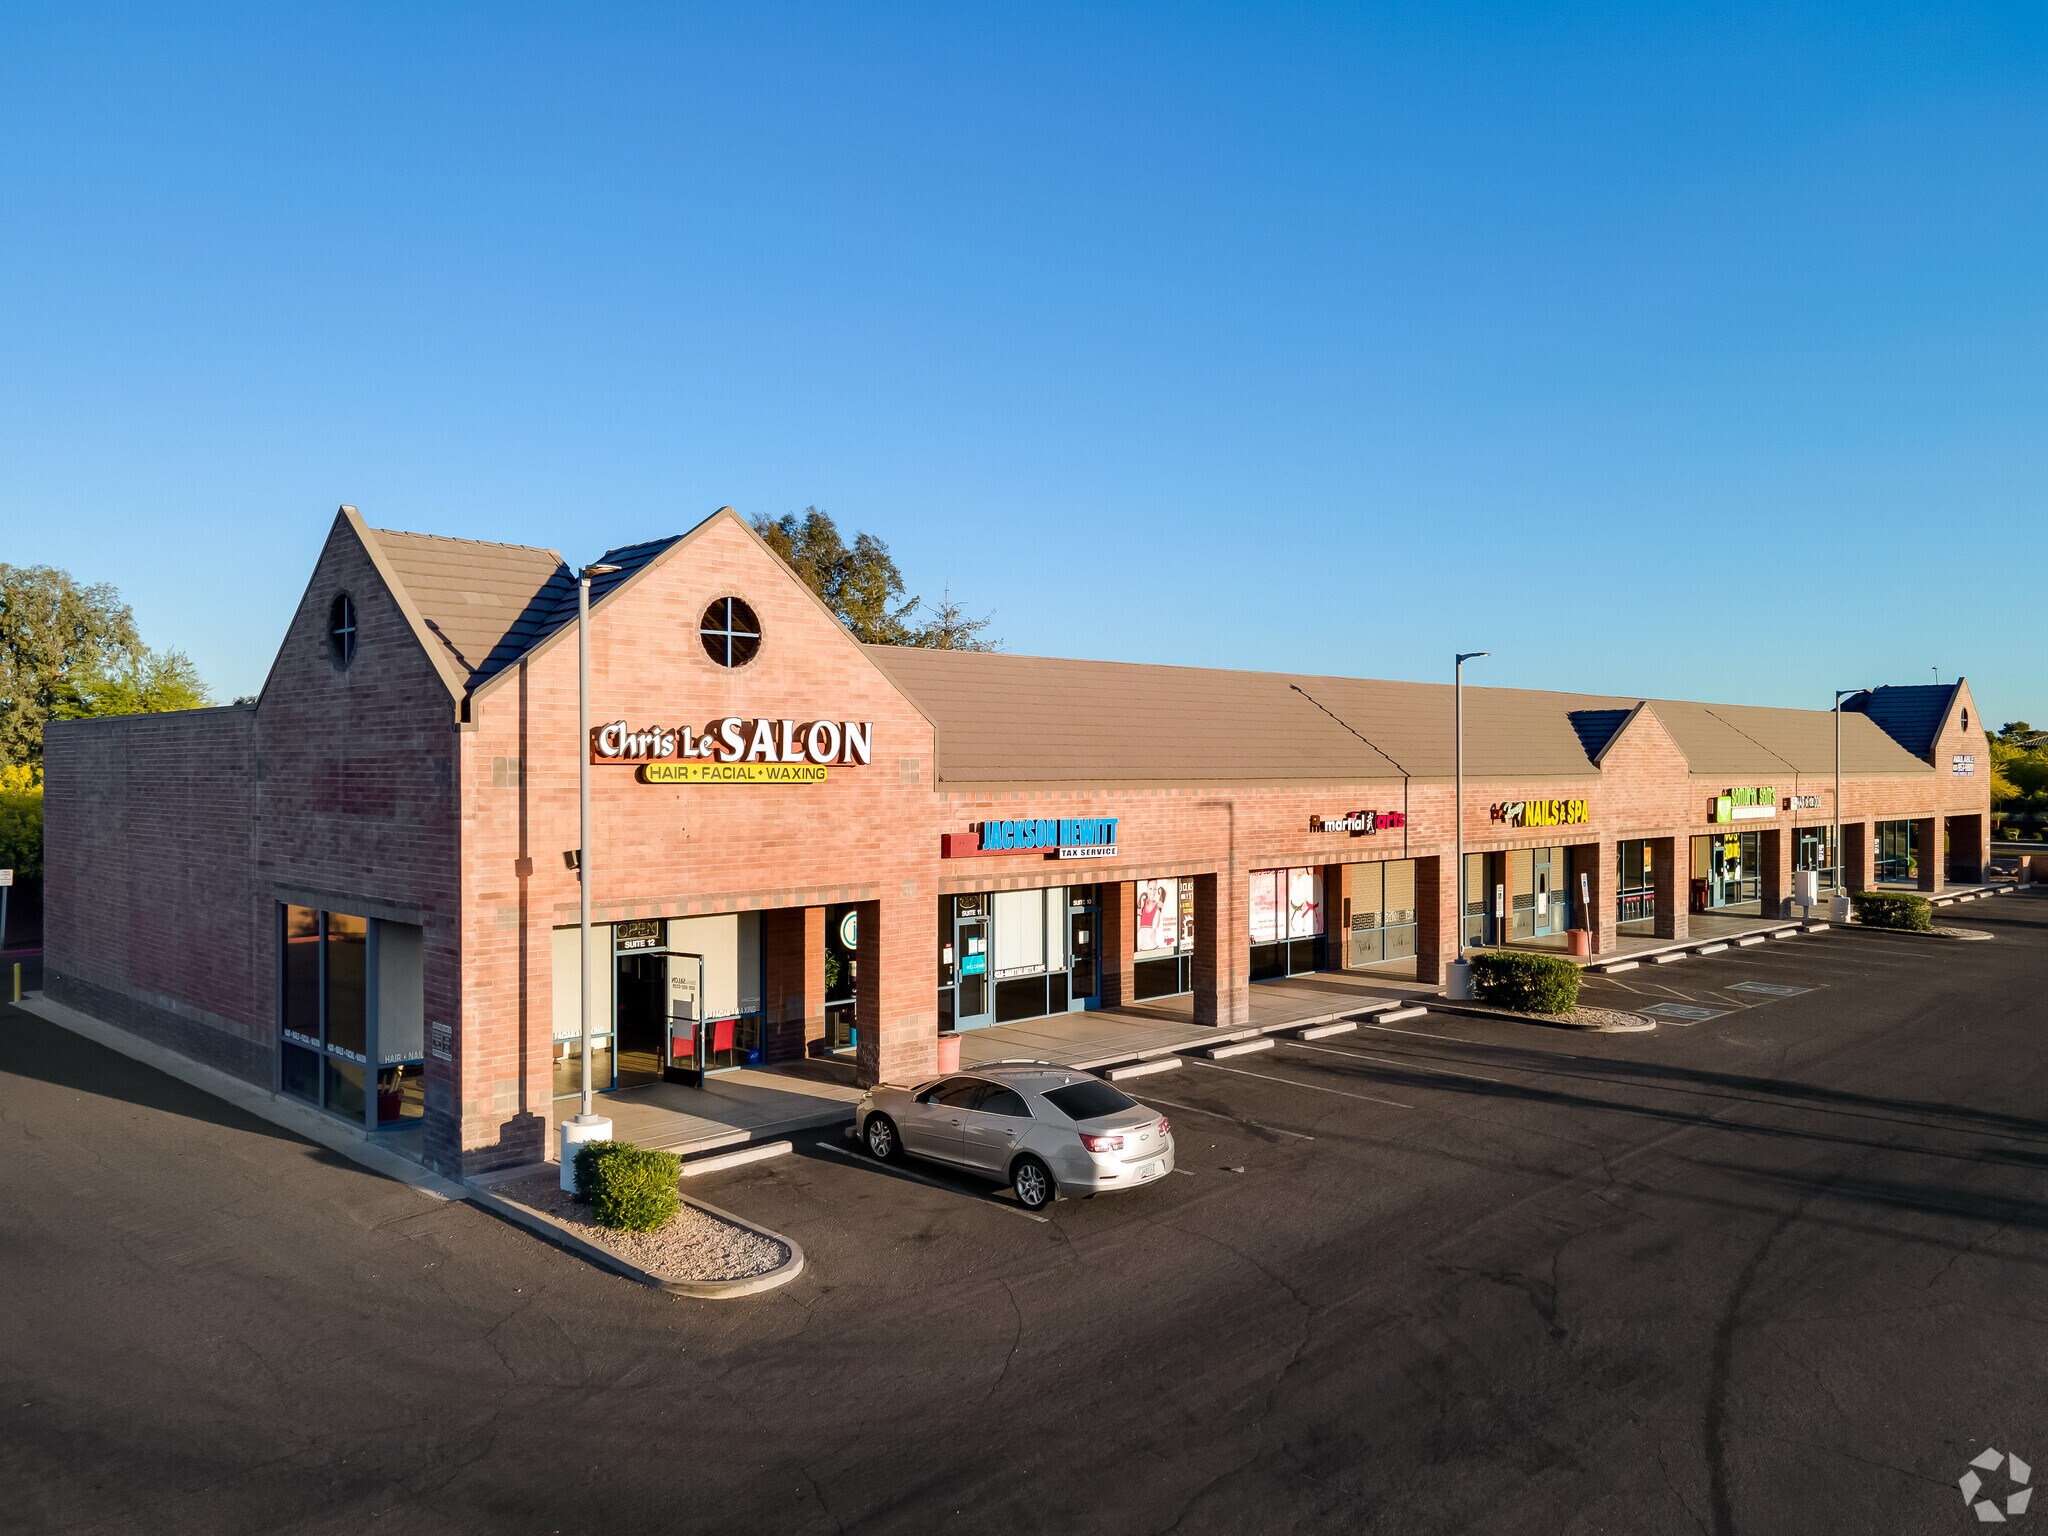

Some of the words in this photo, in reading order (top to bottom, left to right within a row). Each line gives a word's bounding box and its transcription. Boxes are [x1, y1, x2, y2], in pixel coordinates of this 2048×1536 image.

[599, 720, 675, 758] Chris
[682, 725, 714, 758] Le
[720, 716, 874, 766] SALON
[650, 766, 689, 779] HAIR
[701, 766, 756, 780] FACIAL
[766, 766, 826, 780] WAXING
[1324, 814, 1365, 832] martial
[1377, 811, 1405, 829] arts
[1525, 800, 1559, 827] NAILS
[1560, 804, 1566, 821] &
[1567, 799, 1589, 824] SPA
[983, 819, 1057, 850] JACKSON
[1060, 817, 1119, 847] HEWITT
[1062, 849, 1078, 857] TAX
[1080, 848, 1117, 856] SERVICE
[617, 920, 658, 938] OPEN
[624, 940, 646, 949] SUITE
[647, 938, 655, 946] 12
[384, 1054, 402, 1064] HAIR
[408, 1050, 424, 1060] NAIL
